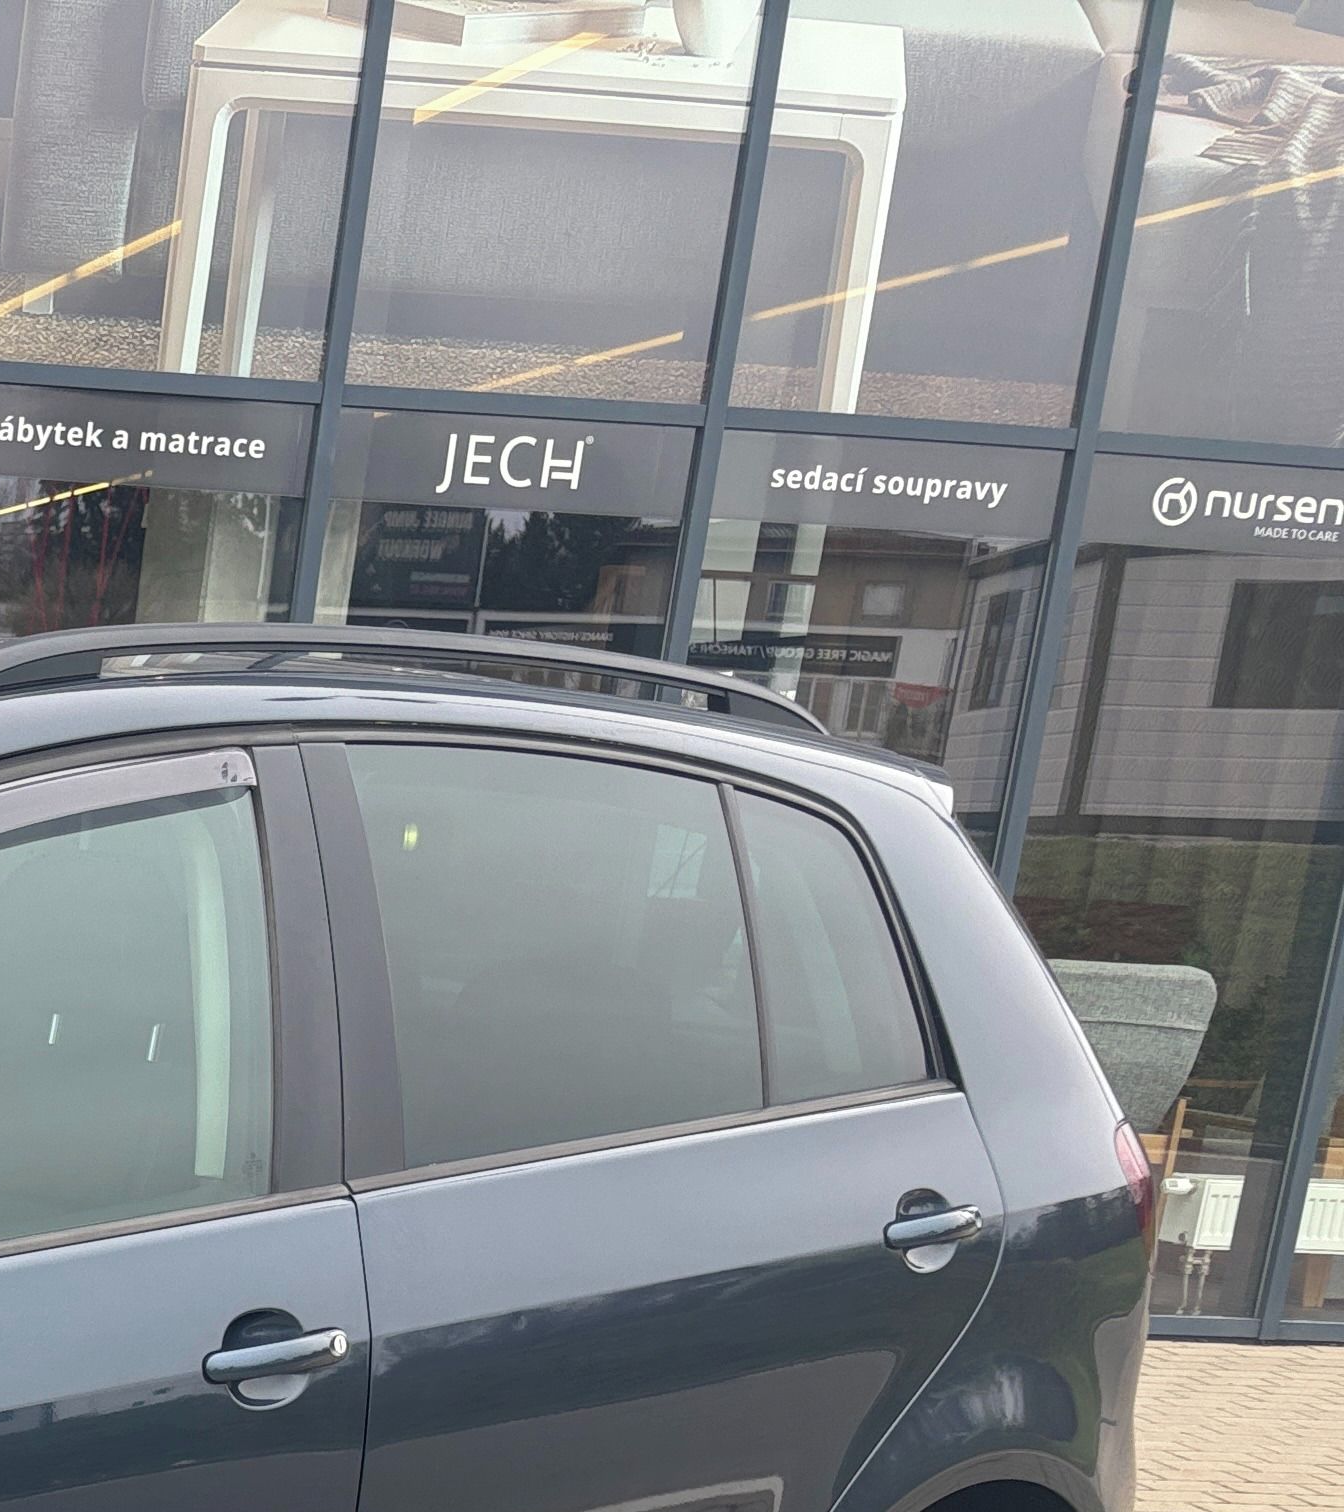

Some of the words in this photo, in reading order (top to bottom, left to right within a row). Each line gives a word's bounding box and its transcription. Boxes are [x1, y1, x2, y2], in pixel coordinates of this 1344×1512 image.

[112, 429, 130, 451] a
[139, 430, 267, 459] matrace
[770, 463, 868, 494] sedací
[871, 474, 1009, 509] soupravy
[1204, 490, 1344, 526] nursen
[1253, 526, 1291, 539] MADE
[1291, 528, 1307, 540] TO
[1307, 530, 1341, 543] CARE
